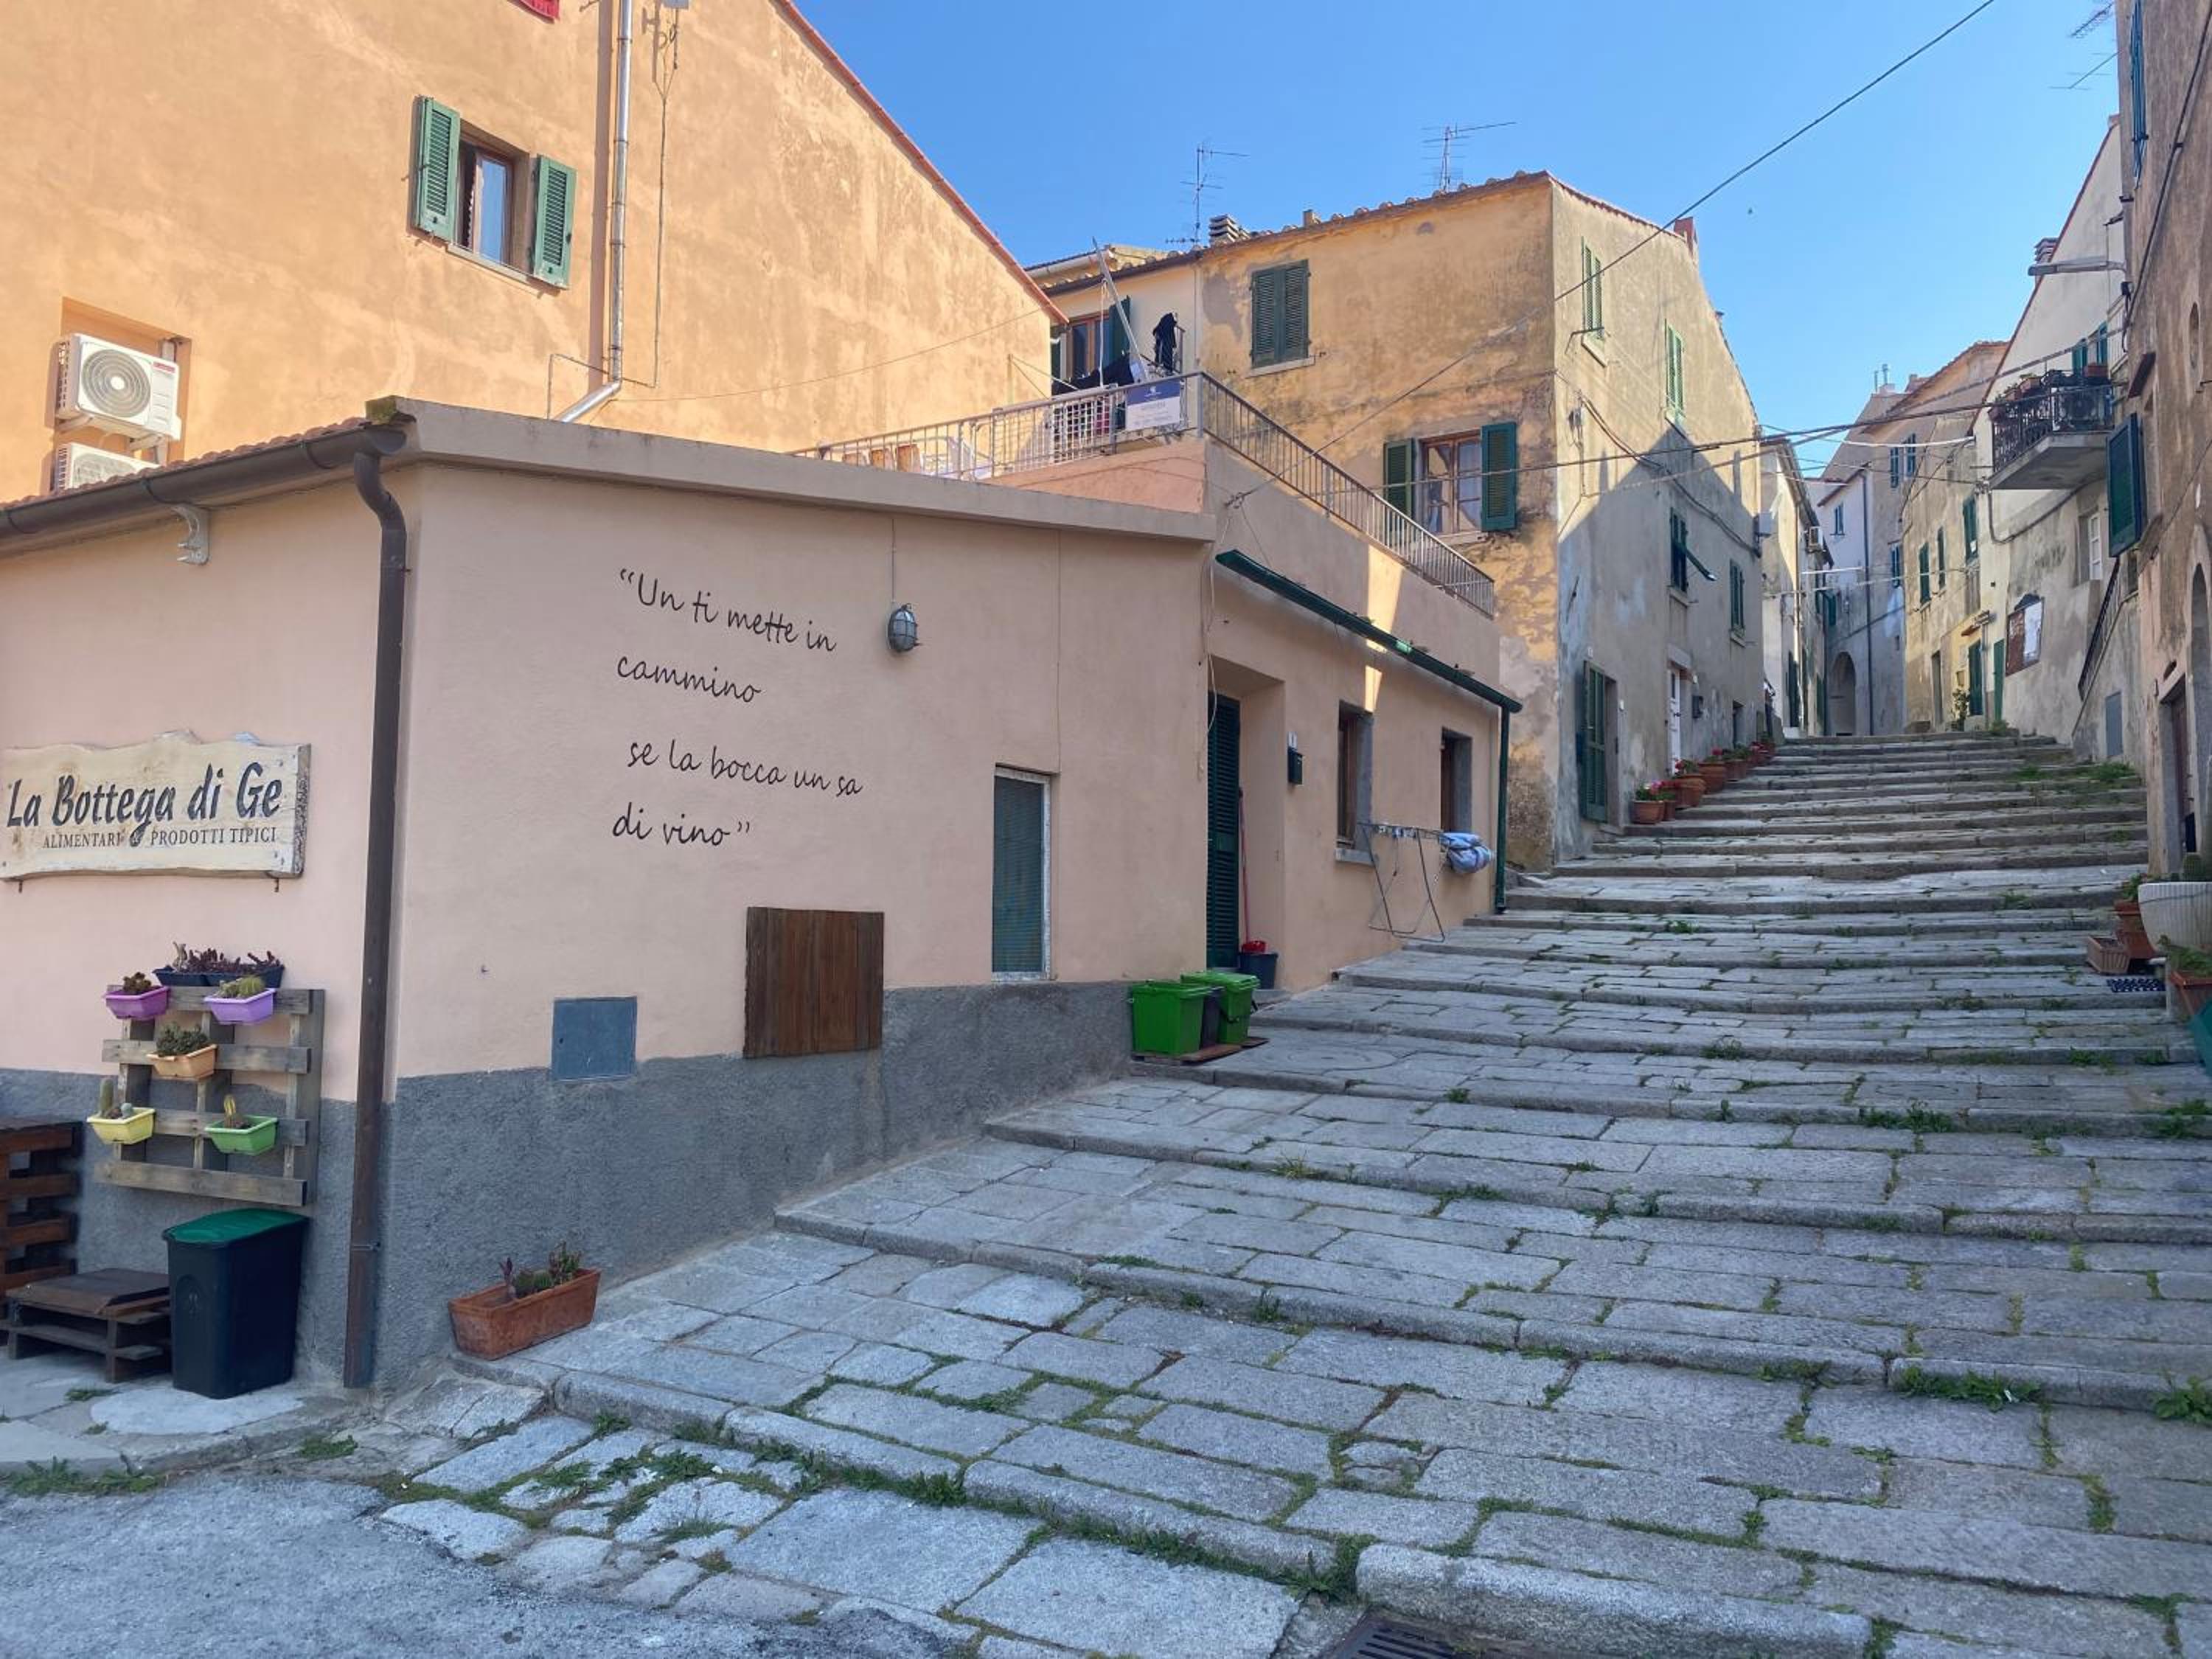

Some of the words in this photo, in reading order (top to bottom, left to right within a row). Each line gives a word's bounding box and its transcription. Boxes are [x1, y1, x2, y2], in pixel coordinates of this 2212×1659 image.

[692, 591, 719, 623] ti
[727, 609, 799, 644] mette
[806, 620, 837, 652] in
[617, 656, 762, 703] cammino
[627, 742, 660, 768] se
[669, 739, 702, 772] la
[710, 745, 787, 785] bocca
[793, 769, 832, 790] un
[835, 775, 864, 797] sa
[7, 779, 42, 827] La
[51, 775, 176, 847] Bottega
[187, 762, 224, 821] di
[236, 762, 282, 818] Ge
[612, 801, 653, 840] di
[43, 832, 120, 848] ALIMENTARI
[150, 828, 224, 846] PRODOTTI
[230, 827, 276, 844] TIPICI
